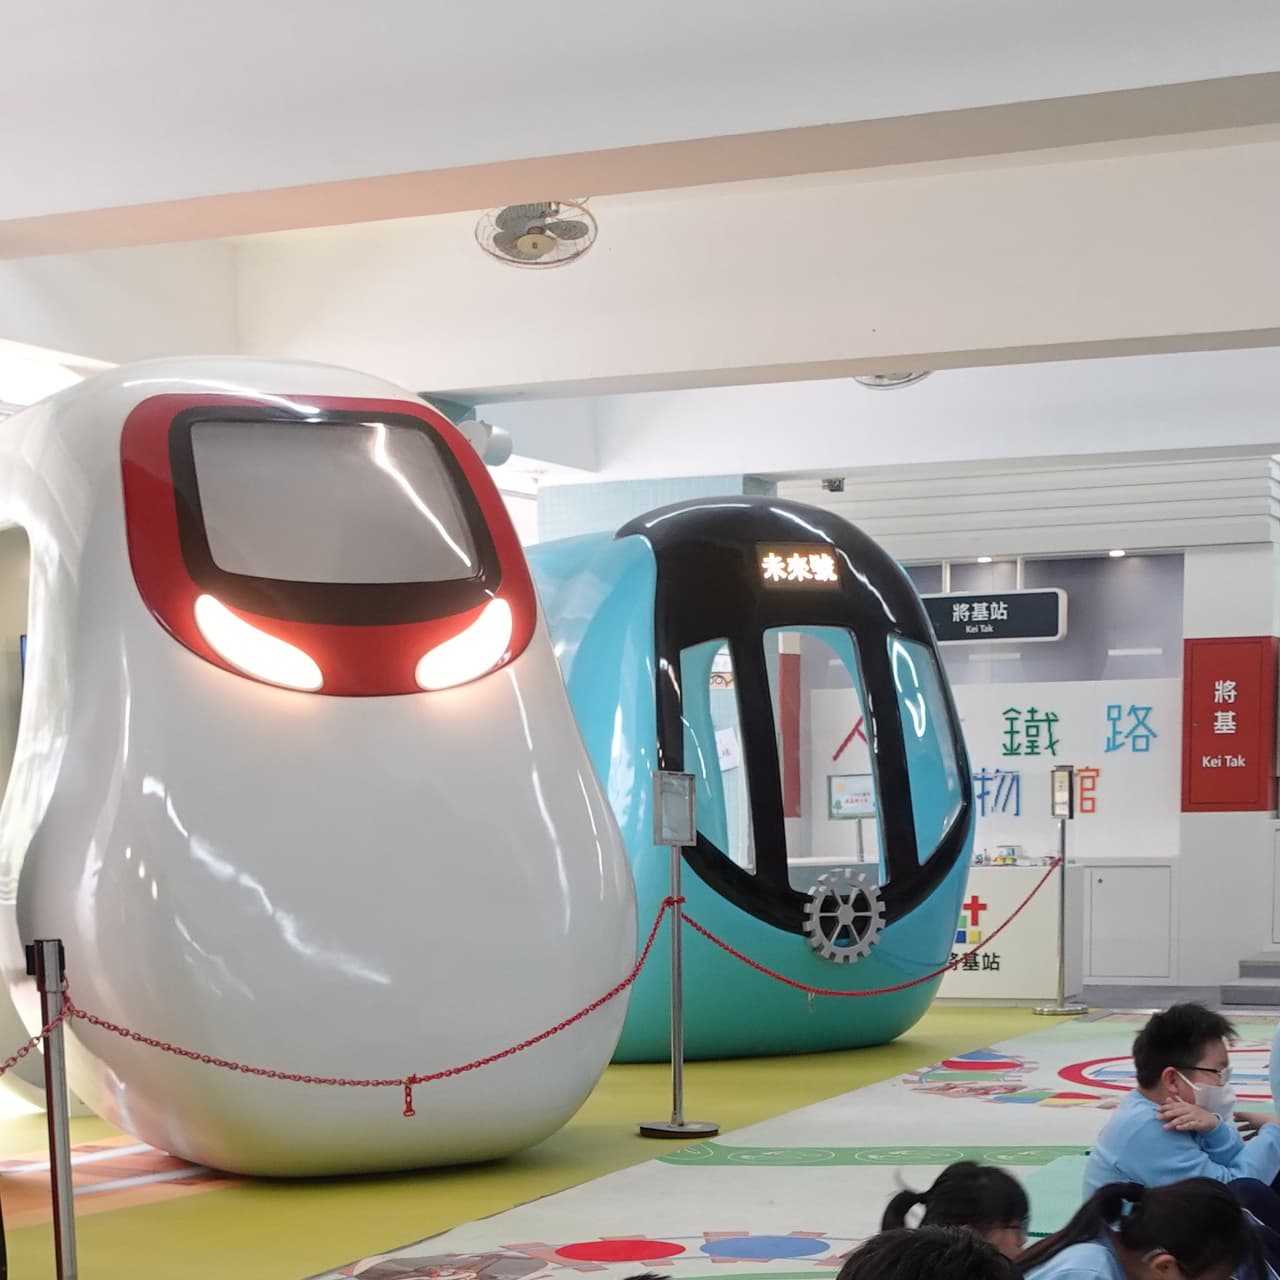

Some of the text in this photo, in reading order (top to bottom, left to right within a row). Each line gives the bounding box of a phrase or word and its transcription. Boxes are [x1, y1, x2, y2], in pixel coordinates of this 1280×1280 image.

[952, 601, 1009, 622] 將基站
[965, 623, 993, 633] Kei Tak
[1213, 680, 1238, 735] 將基
[1202, 754, 1246, 768] Kei Tak
